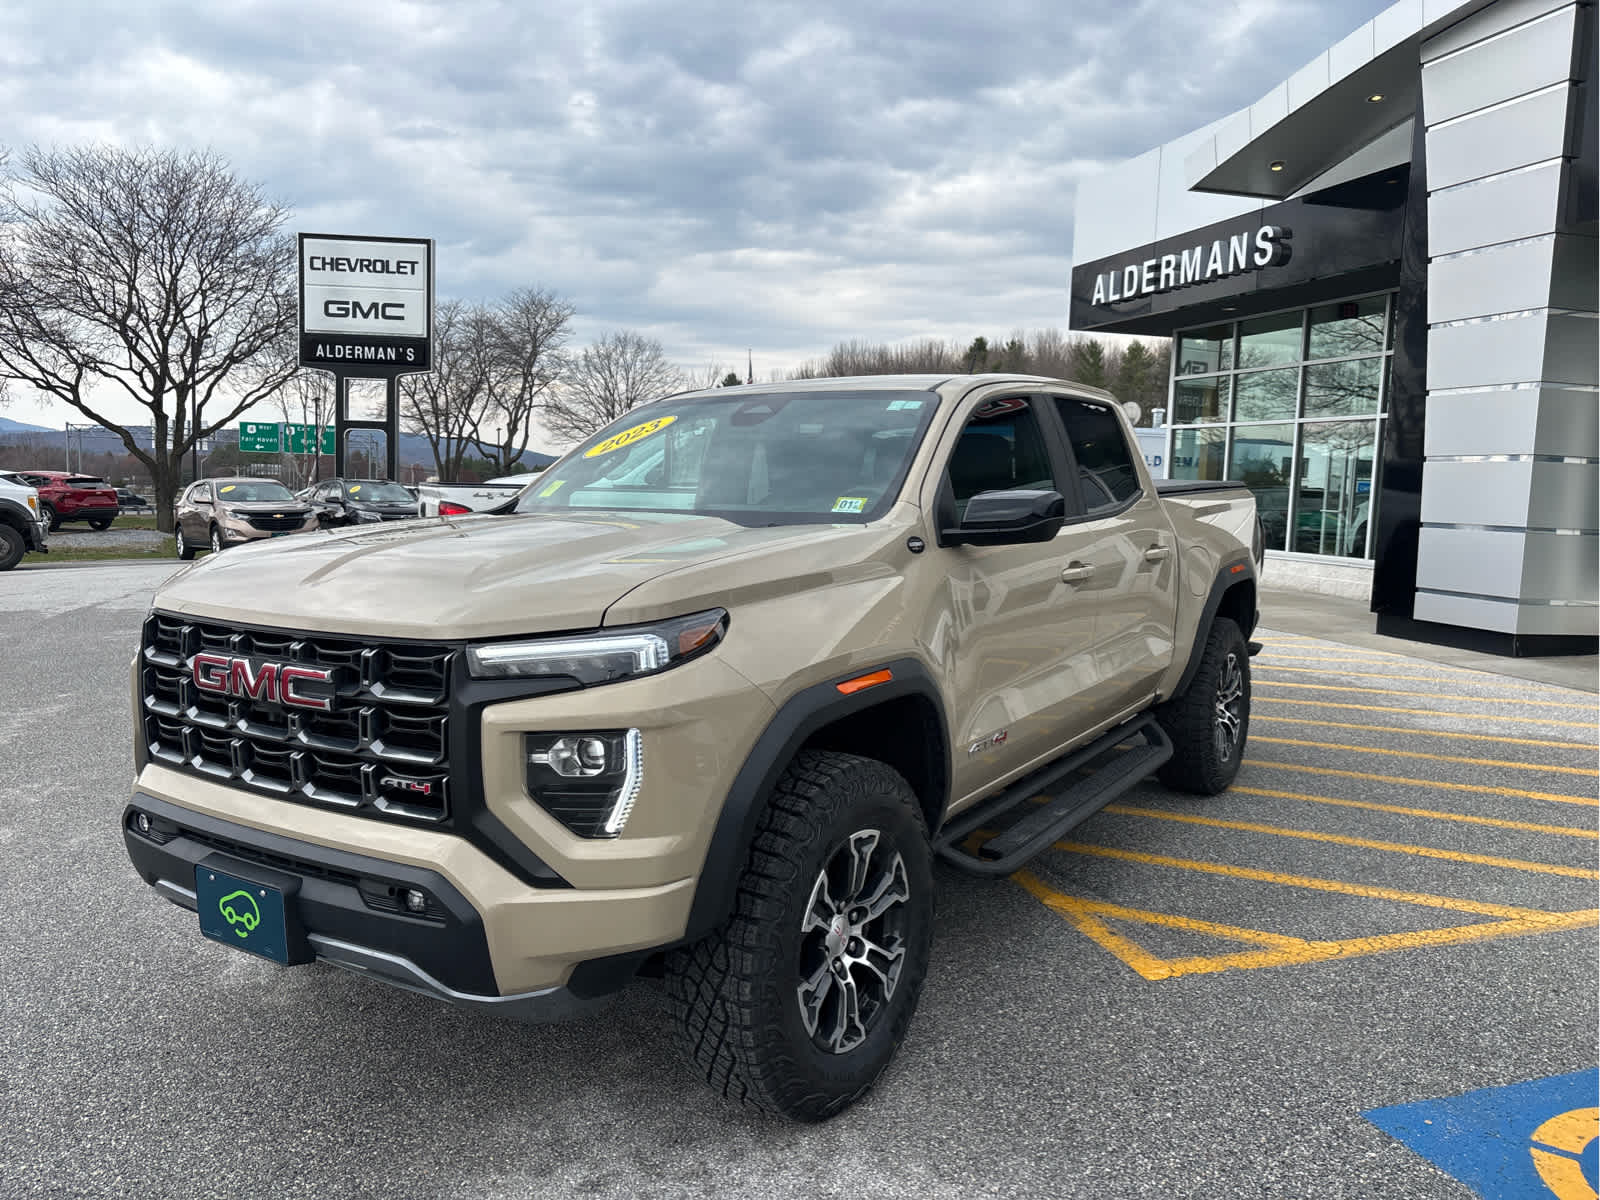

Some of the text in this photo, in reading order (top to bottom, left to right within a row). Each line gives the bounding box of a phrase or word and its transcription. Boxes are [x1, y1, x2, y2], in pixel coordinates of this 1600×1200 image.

[309, 256, 419, 275] CHEVROLET
[1091, 225, 1274, 306] ALDERMANS
[323, 300, 405, 320] GMC
[315, 344, 415, 361] ALDERMAN'S
[599, 420, 662, 453] 2023
[193, 652, 332, 712] GMC
[380, 777, 431, 795] AT4
